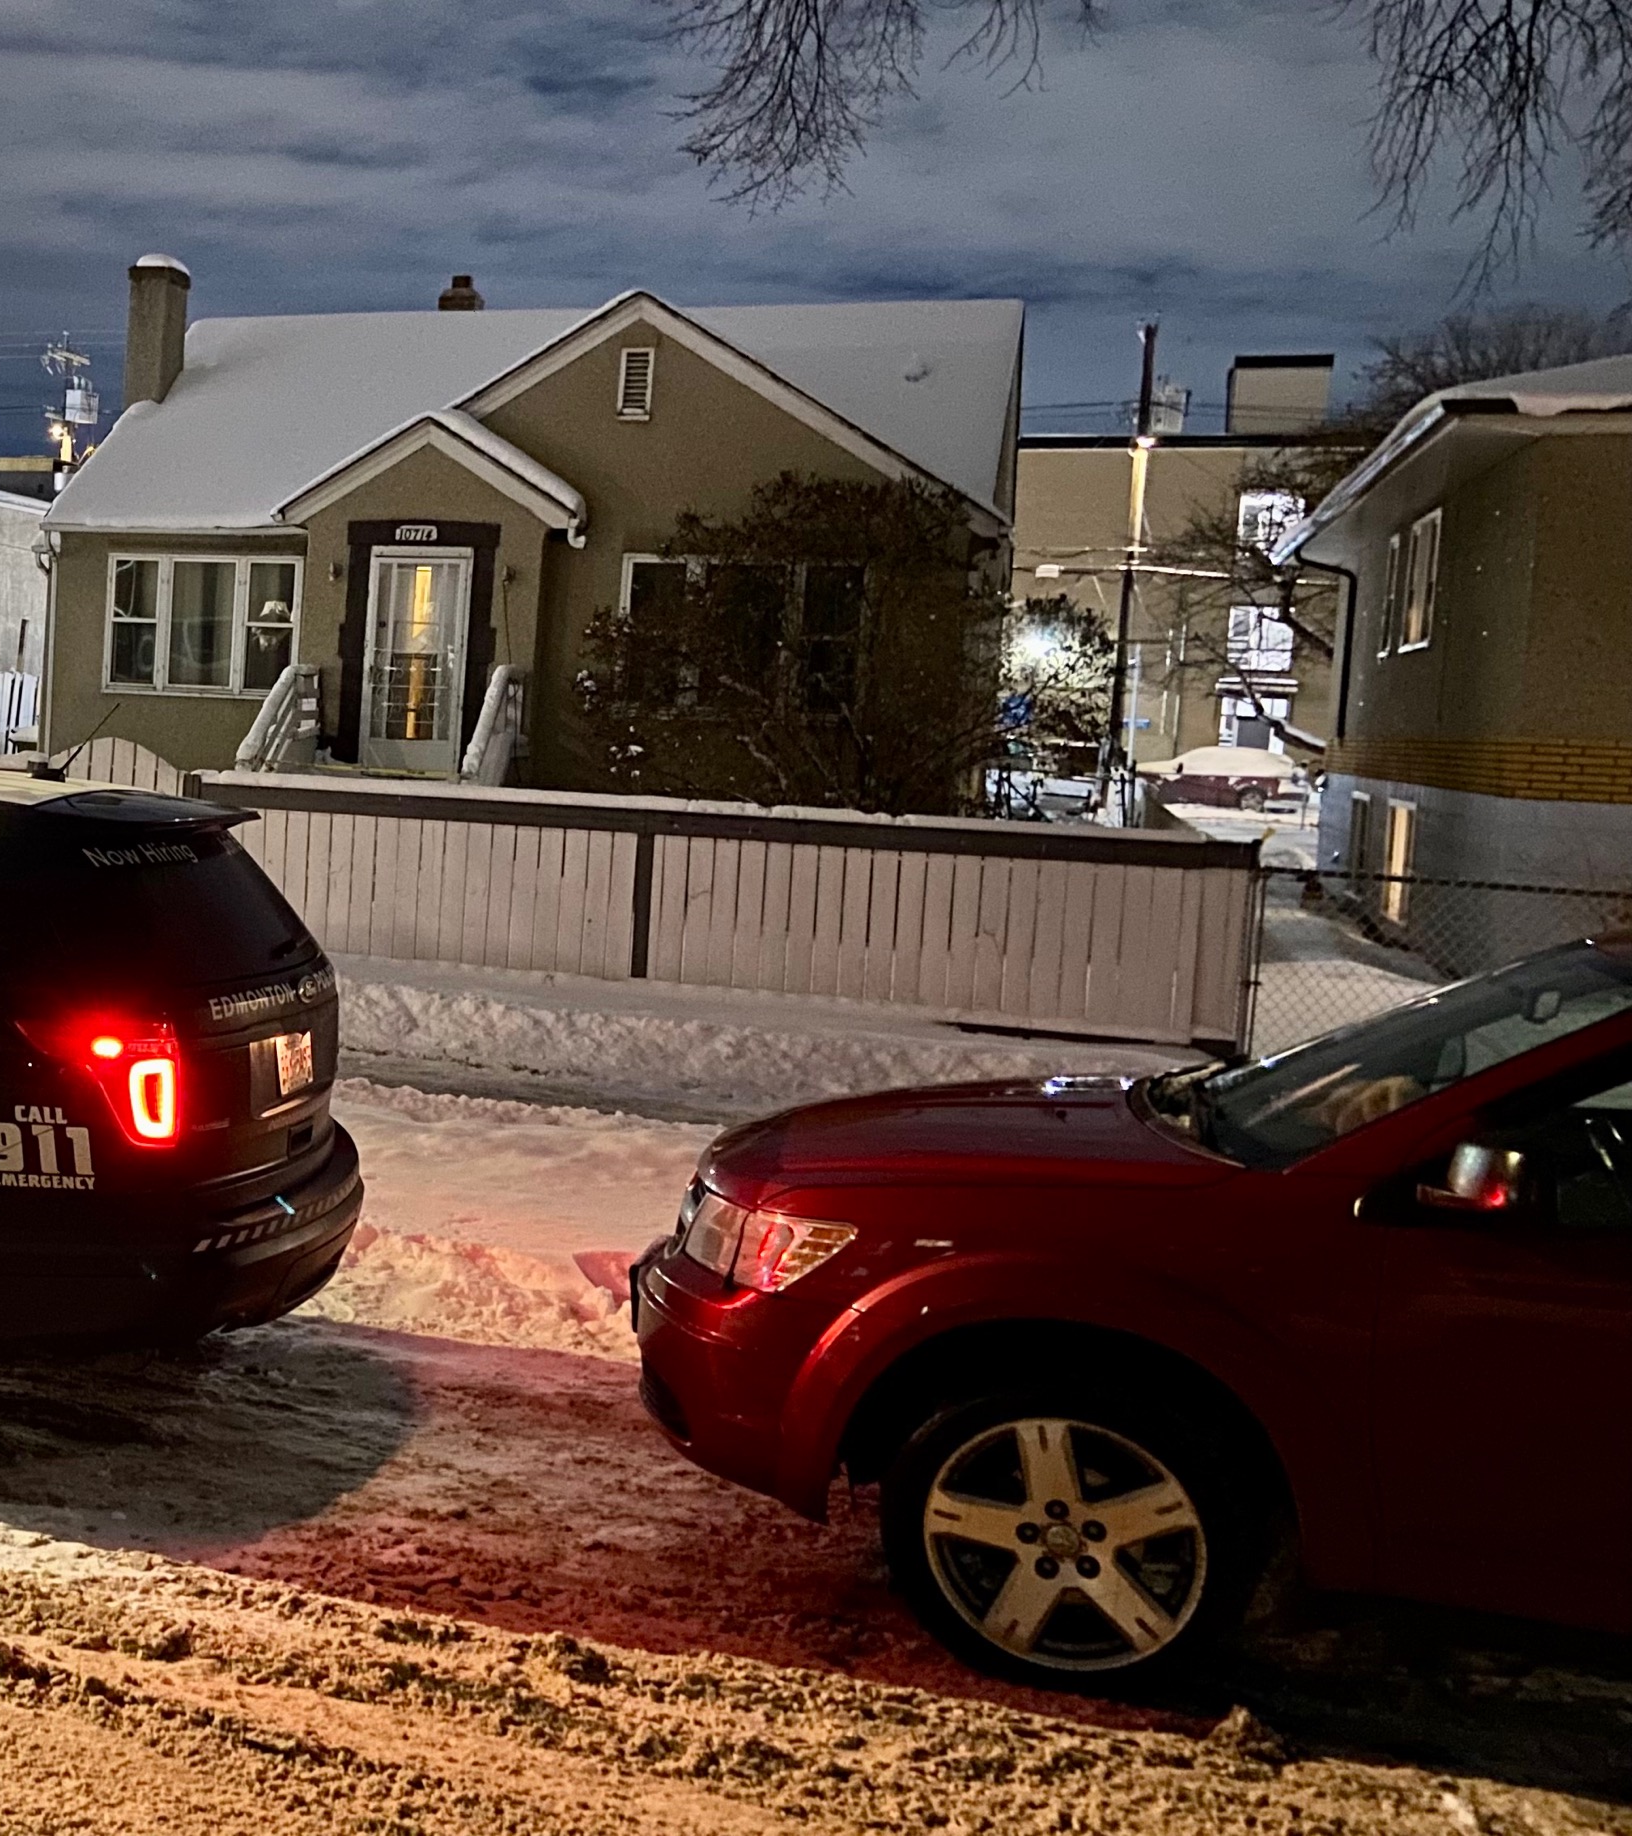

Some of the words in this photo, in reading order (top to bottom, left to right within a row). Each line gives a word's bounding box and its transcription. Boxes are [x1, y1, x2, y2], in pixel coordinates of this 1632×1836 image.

[398, 528, 434, 541] 10714
[137, 842, 199, 863] Hiring
[208, 982, 295, 1020] EDMONTON
[14, 1105, 68, 1124] CALL
